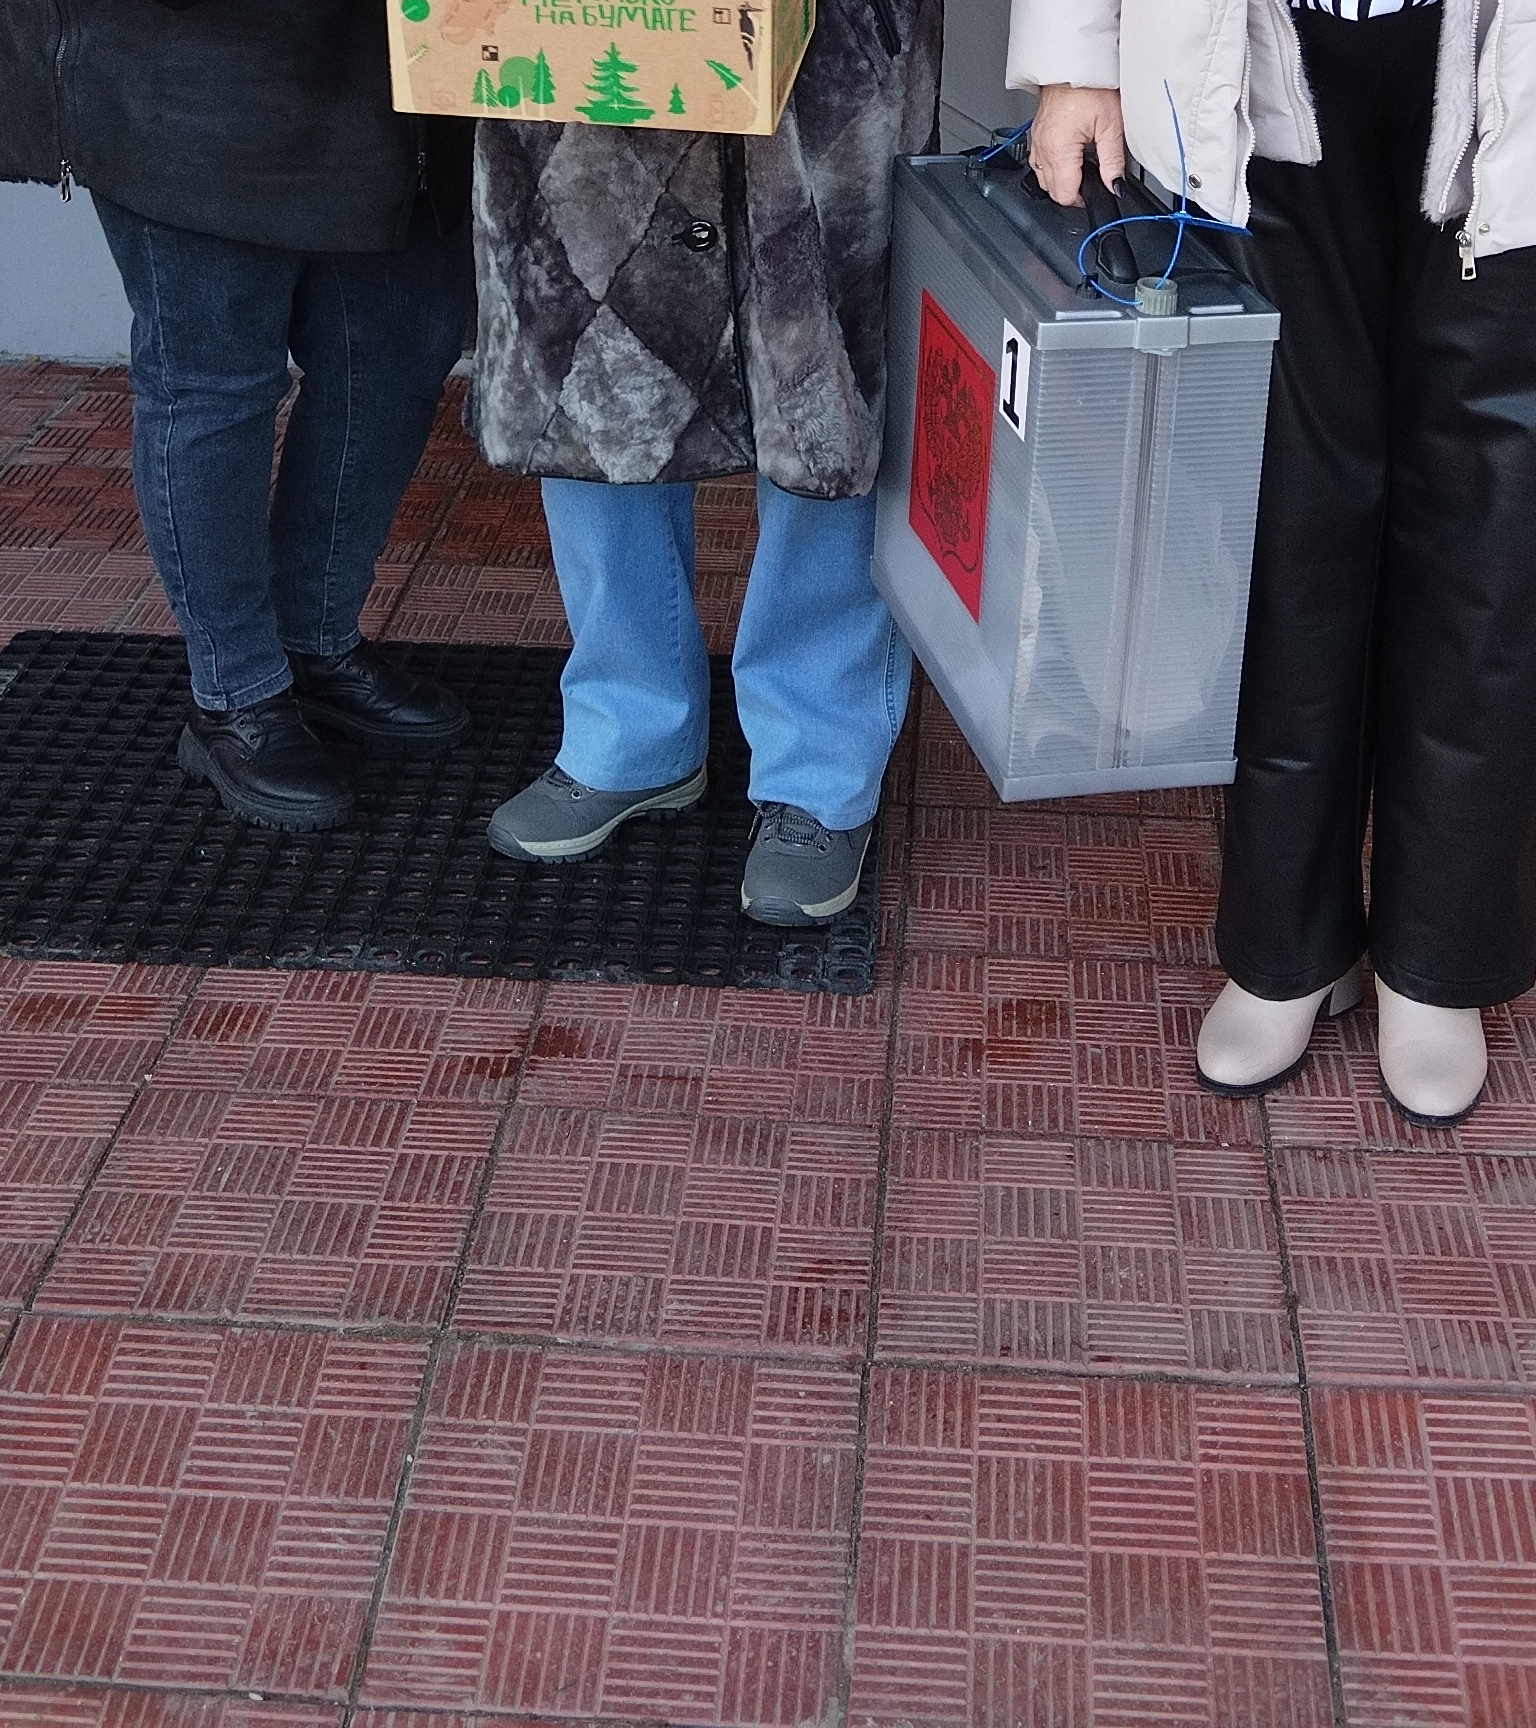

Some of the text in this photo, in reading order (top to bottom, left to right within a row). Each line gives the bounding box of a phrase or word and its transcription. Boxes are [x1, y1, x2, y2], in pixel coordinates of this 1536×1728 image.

[535, 4, 697, 32] НА БУМАГЕ
[1002, 337, 1020, 429] 1
